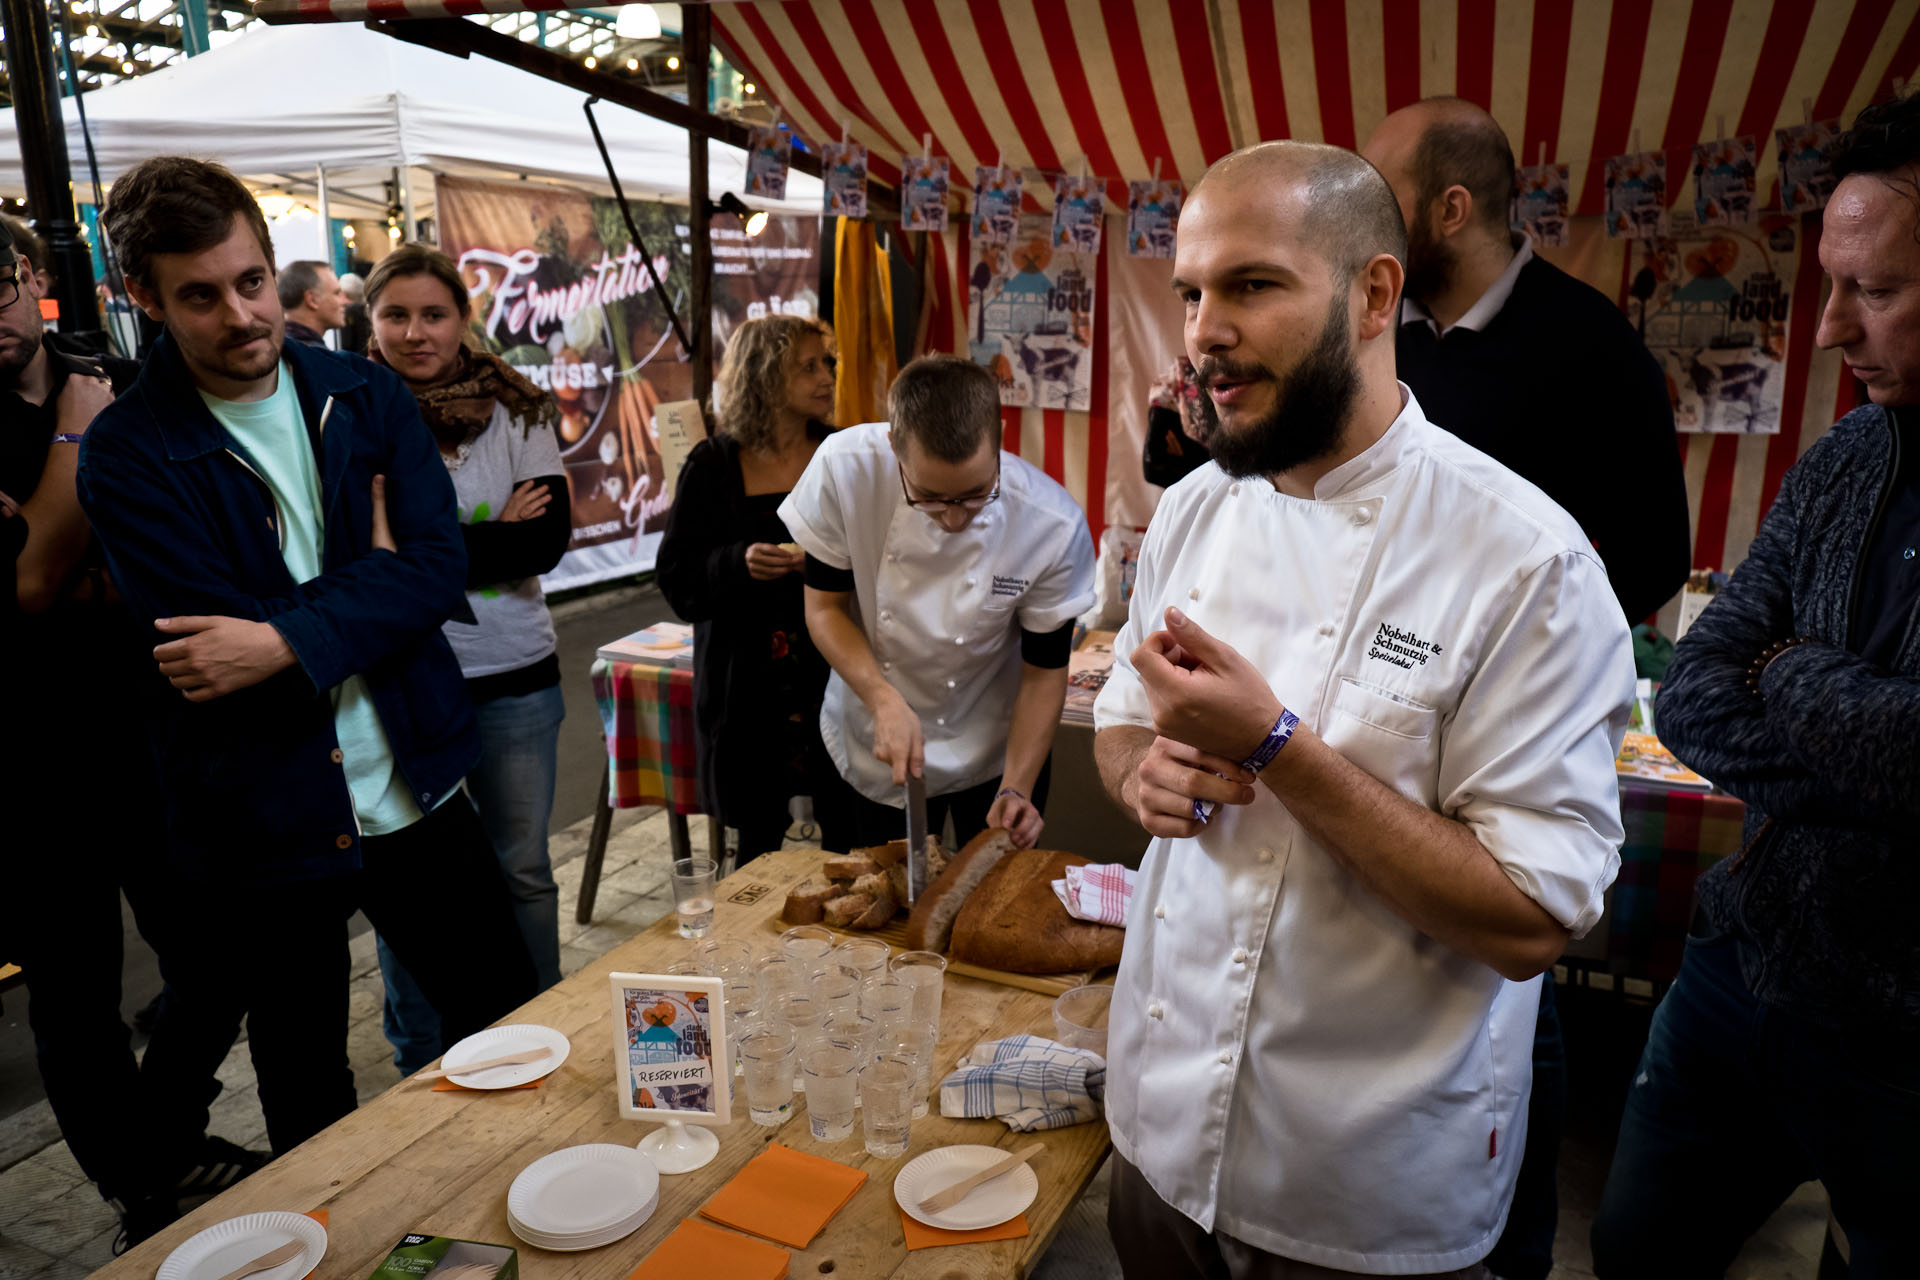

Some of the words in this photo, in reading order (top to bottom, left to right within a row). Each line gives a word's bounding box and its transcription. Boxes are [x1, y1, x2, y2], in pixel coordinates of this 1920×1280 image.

[457, 242, 669, 344] Fermentation
[1057, 275, 1086, 292] land
[1743, 279, 1782, 298] land
[1047, 287, 1092, 313] food
[1729, 293, 1790, 322] food
[1377, 622, 1431, 651] Nobelhart
[1430, 643, 1444, 656] &
[1373, 634, 1430, 666] Schmutzig
[682, 1028, 708, 1042] land
[675, 1037, 712, 1057] food
[638, 1066, 706, 1083] RESERVIERT
[386, 1255, 413, 1267] 100
